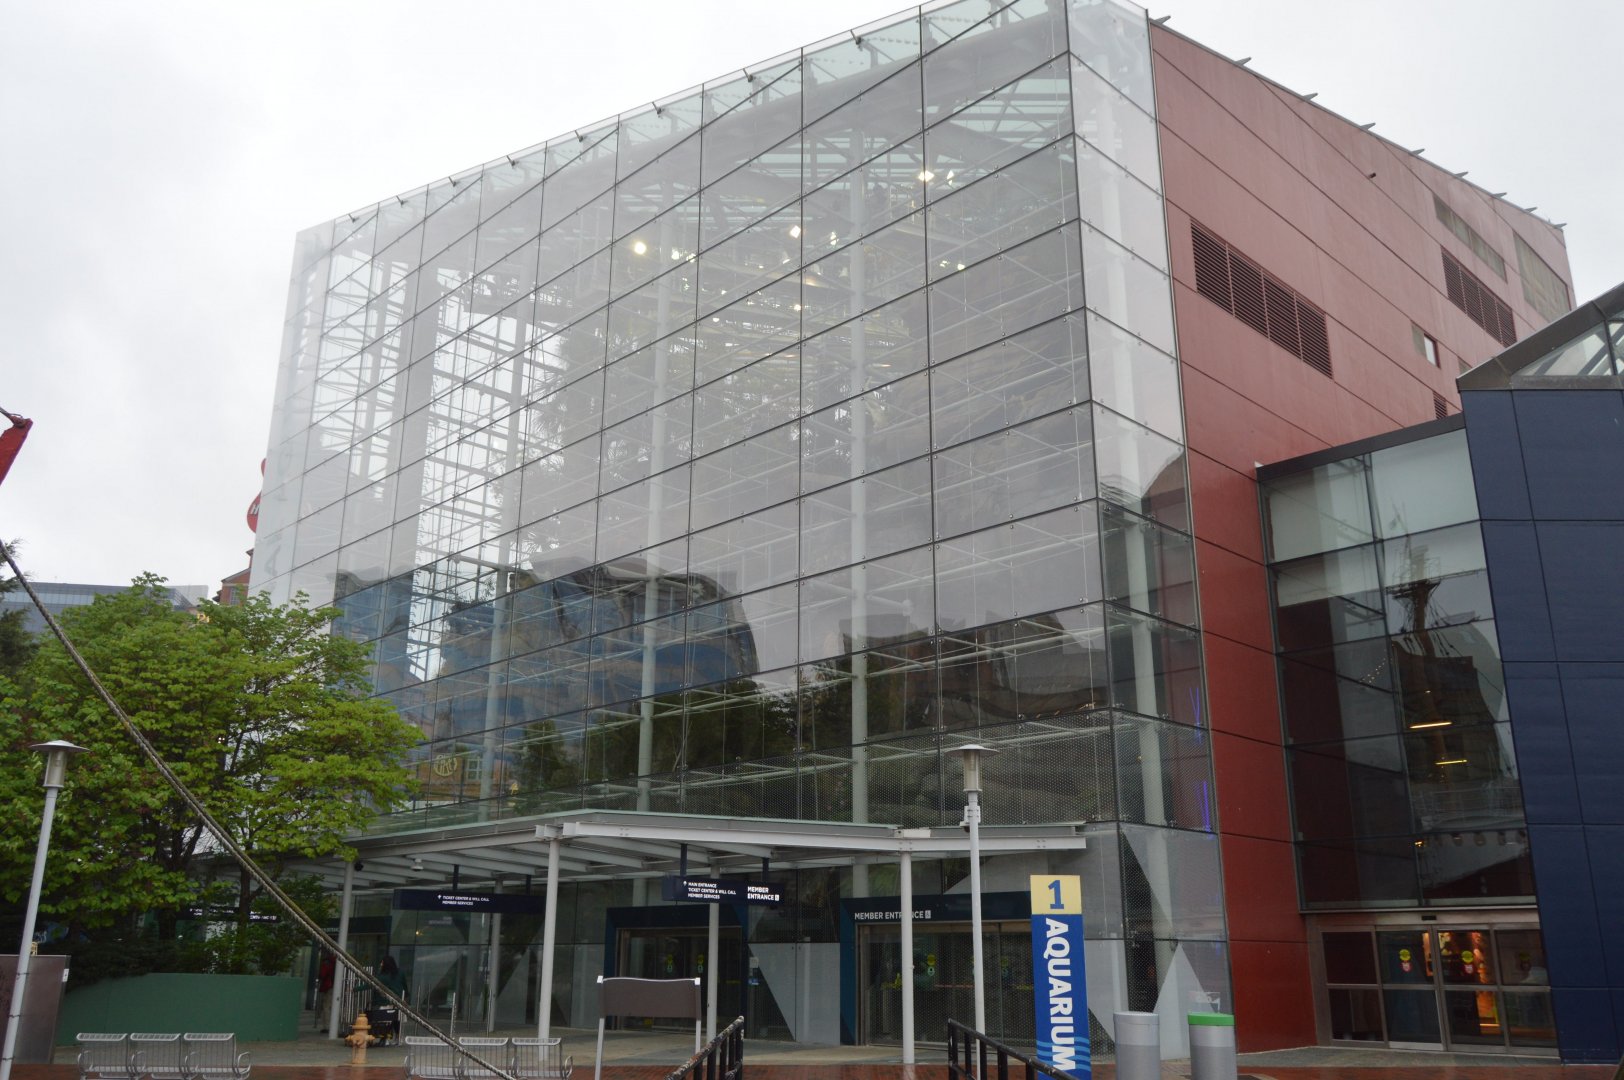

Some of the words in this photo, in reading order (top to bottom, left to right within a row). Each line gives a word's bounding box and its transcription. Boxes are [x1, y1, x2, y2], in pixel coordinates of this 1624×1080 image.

[747, 893, 774, 901] ENTRANCE
[1048, 879, 1064, 910] 1
[854, 911, 883, 920] MEMBER
[885, 910, 924, 920] ENTRCE
[1043, 917, 1076, 1071] AQUARIUM
